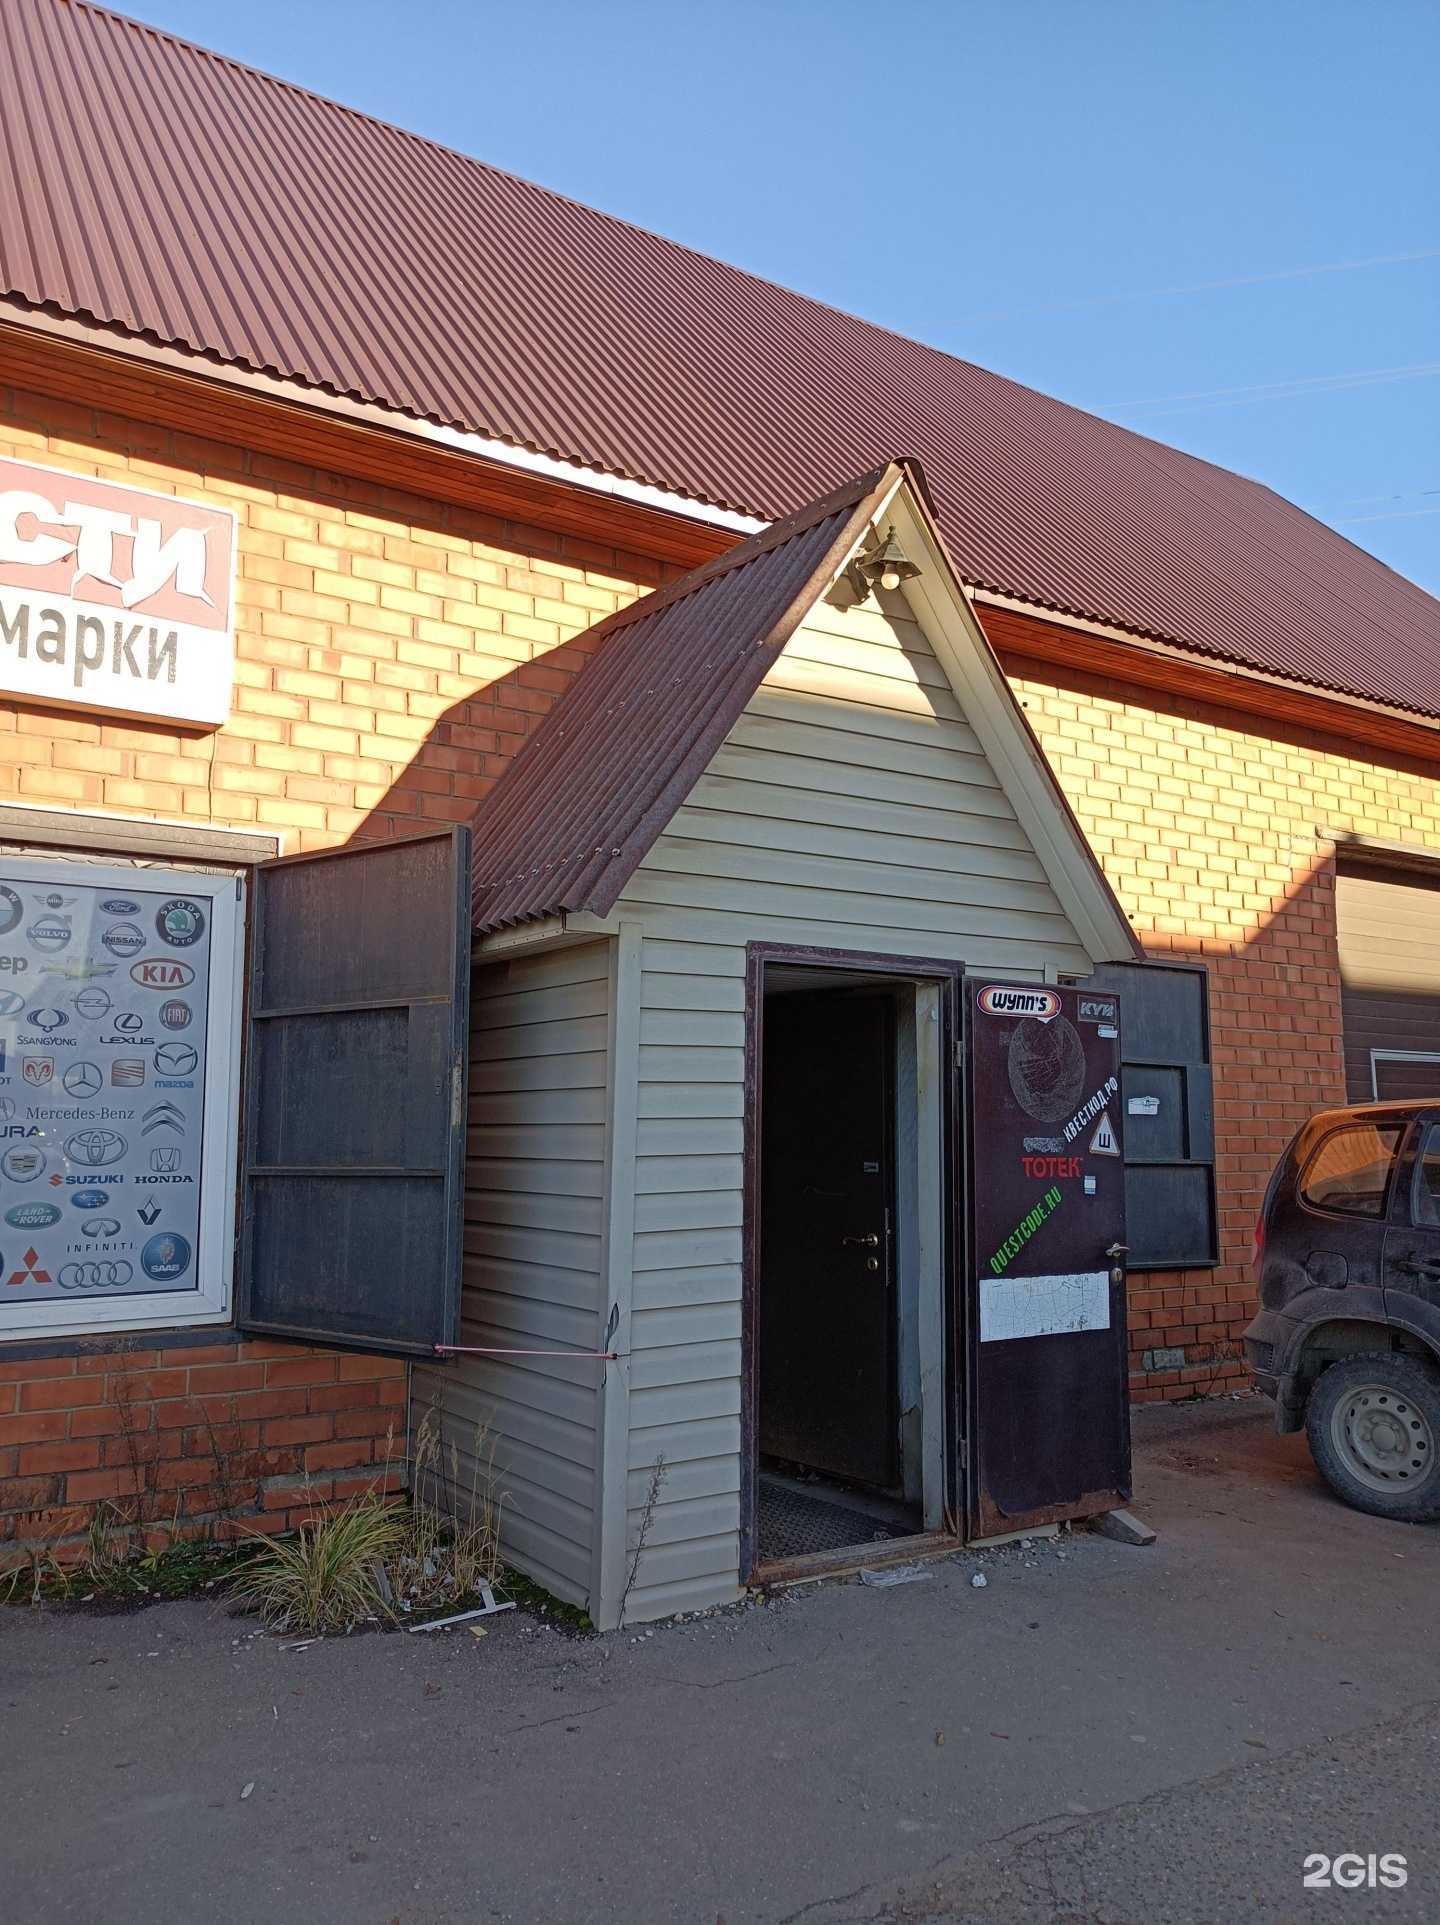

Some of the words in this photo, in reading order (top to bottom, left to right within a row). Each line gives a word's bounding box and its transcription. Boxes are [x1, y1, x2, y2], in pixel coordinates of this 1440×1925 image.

[31, 927, 68, 938] VOLVO
[105, 935, 142, 945] NISSAN
[142, 964, 184, 983] KIA
[167, 1008, 186, 1022] FIAT
[99, 1035, 155, 1045] LEXUS
[25, 1106, 135, 1121] Mercedes-Benz
[1062, 1076, 1119, 1143] КВЕСТКОД.РФ
[1098, 1132, 1111, 1149] Ш
[65, 1174, 124, 1185] SUZUKI
[134, 1175, 194, 1185] HONDA
[990, 1186, 1063, 1274] QUESTCODE.RU
[66, 1241, 134, 1253] INFINITI
[151, 1264, 180, 1272] SAAB
